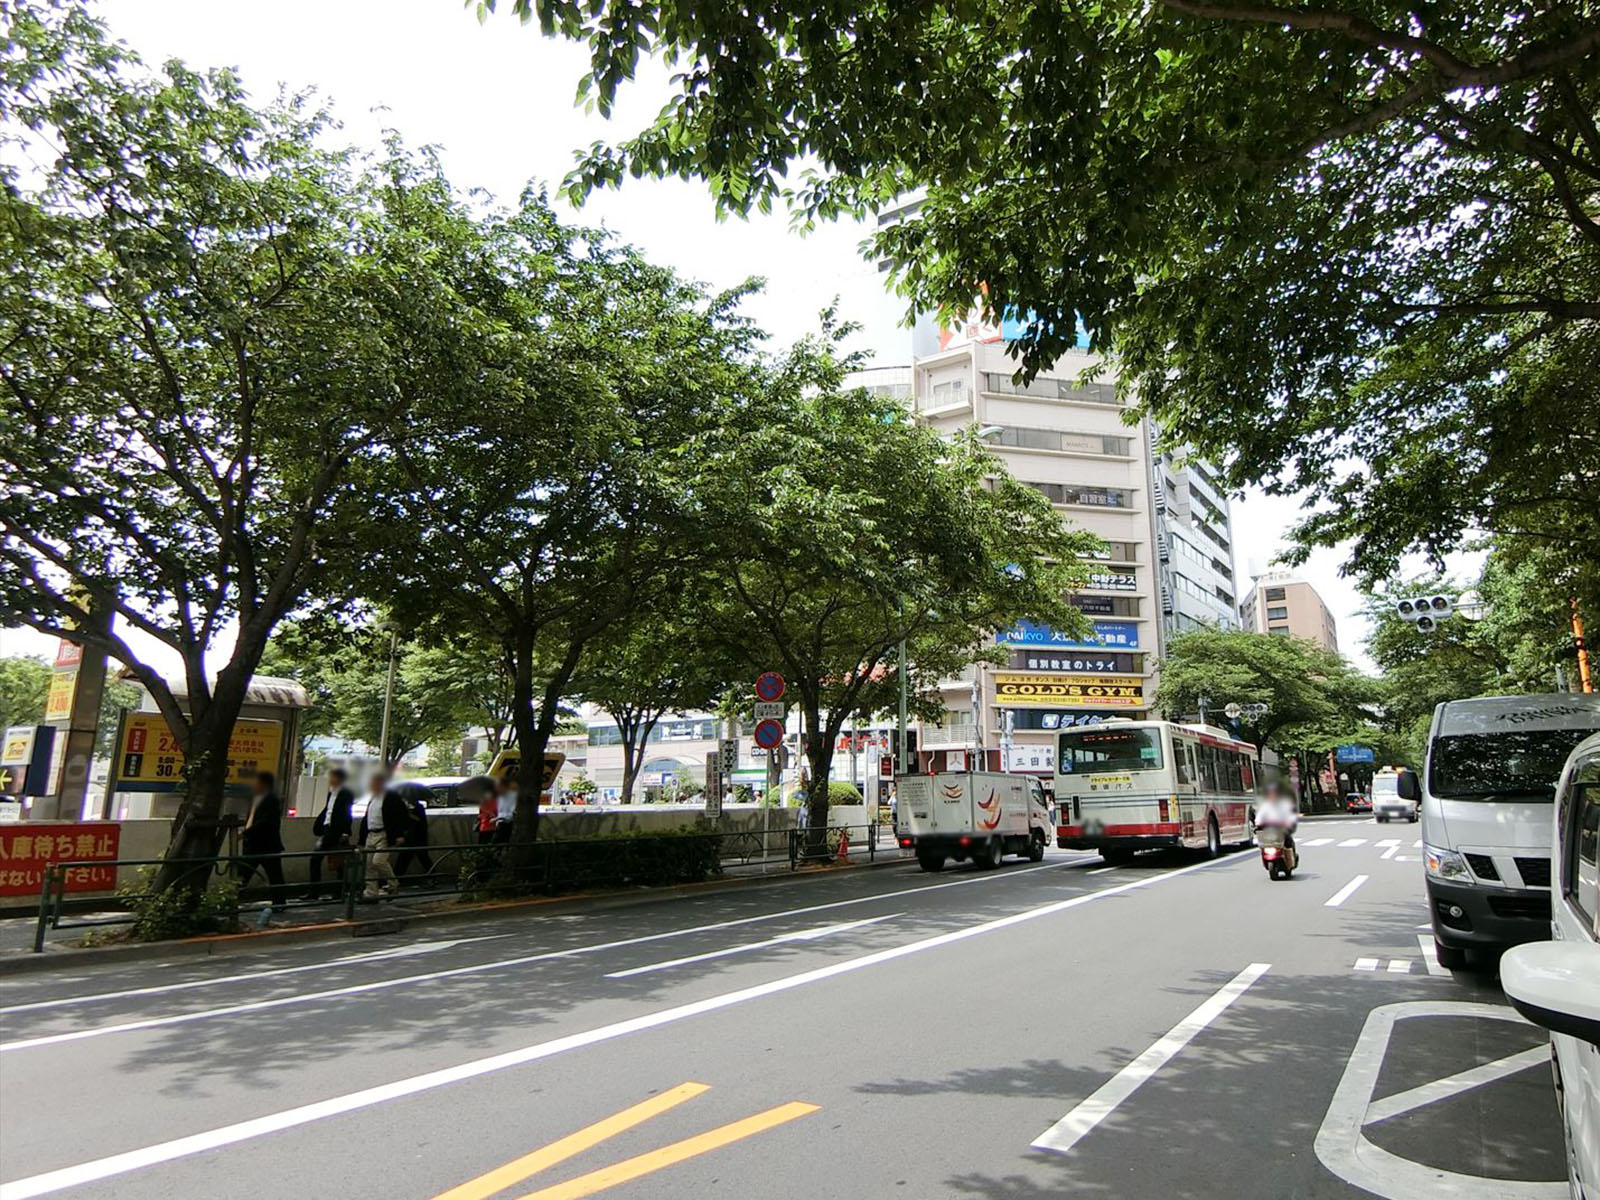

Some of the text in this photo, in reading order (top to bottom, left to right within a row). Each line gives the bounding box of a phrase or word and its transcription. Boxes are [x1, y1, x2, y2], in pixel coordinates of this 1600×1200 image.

[1028, 658, 1116, 671] 個別教室のトライ
[1001, 685, 1136, 697] GOLD'S GYM
